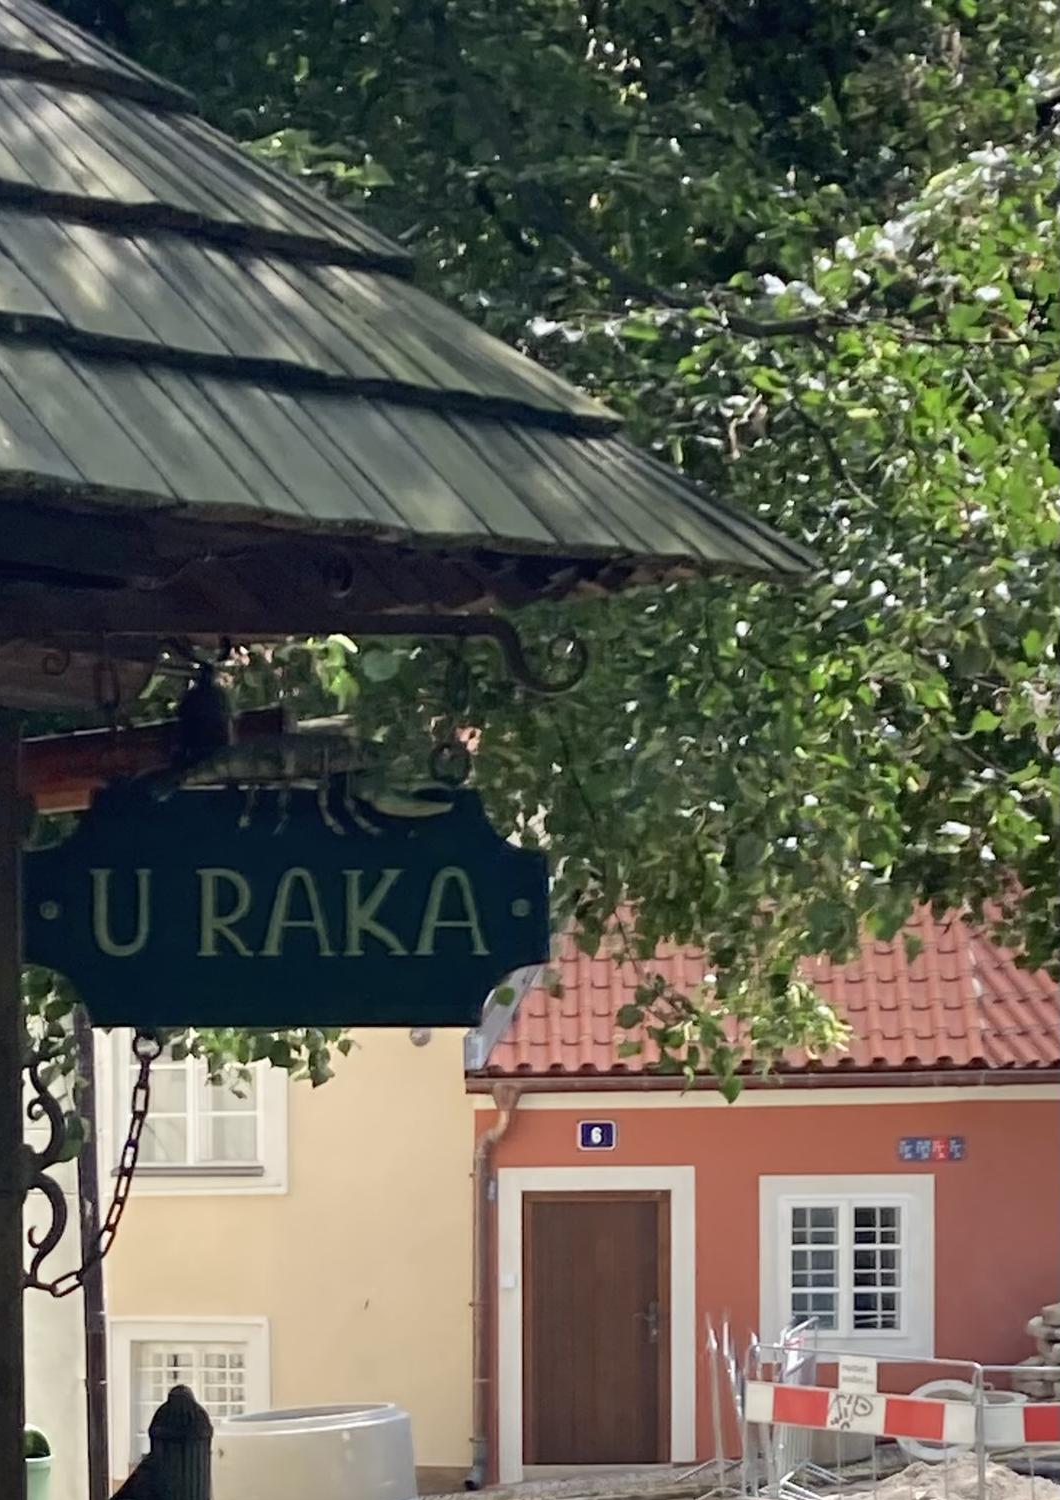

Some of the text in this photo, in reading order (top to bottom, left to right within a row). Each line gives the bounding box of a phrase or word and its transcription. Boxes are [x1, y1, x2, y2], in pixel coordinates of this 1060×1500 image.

[90, 866, 491, 957] U RAKA
[591, 1126, 602, 1145] 6
